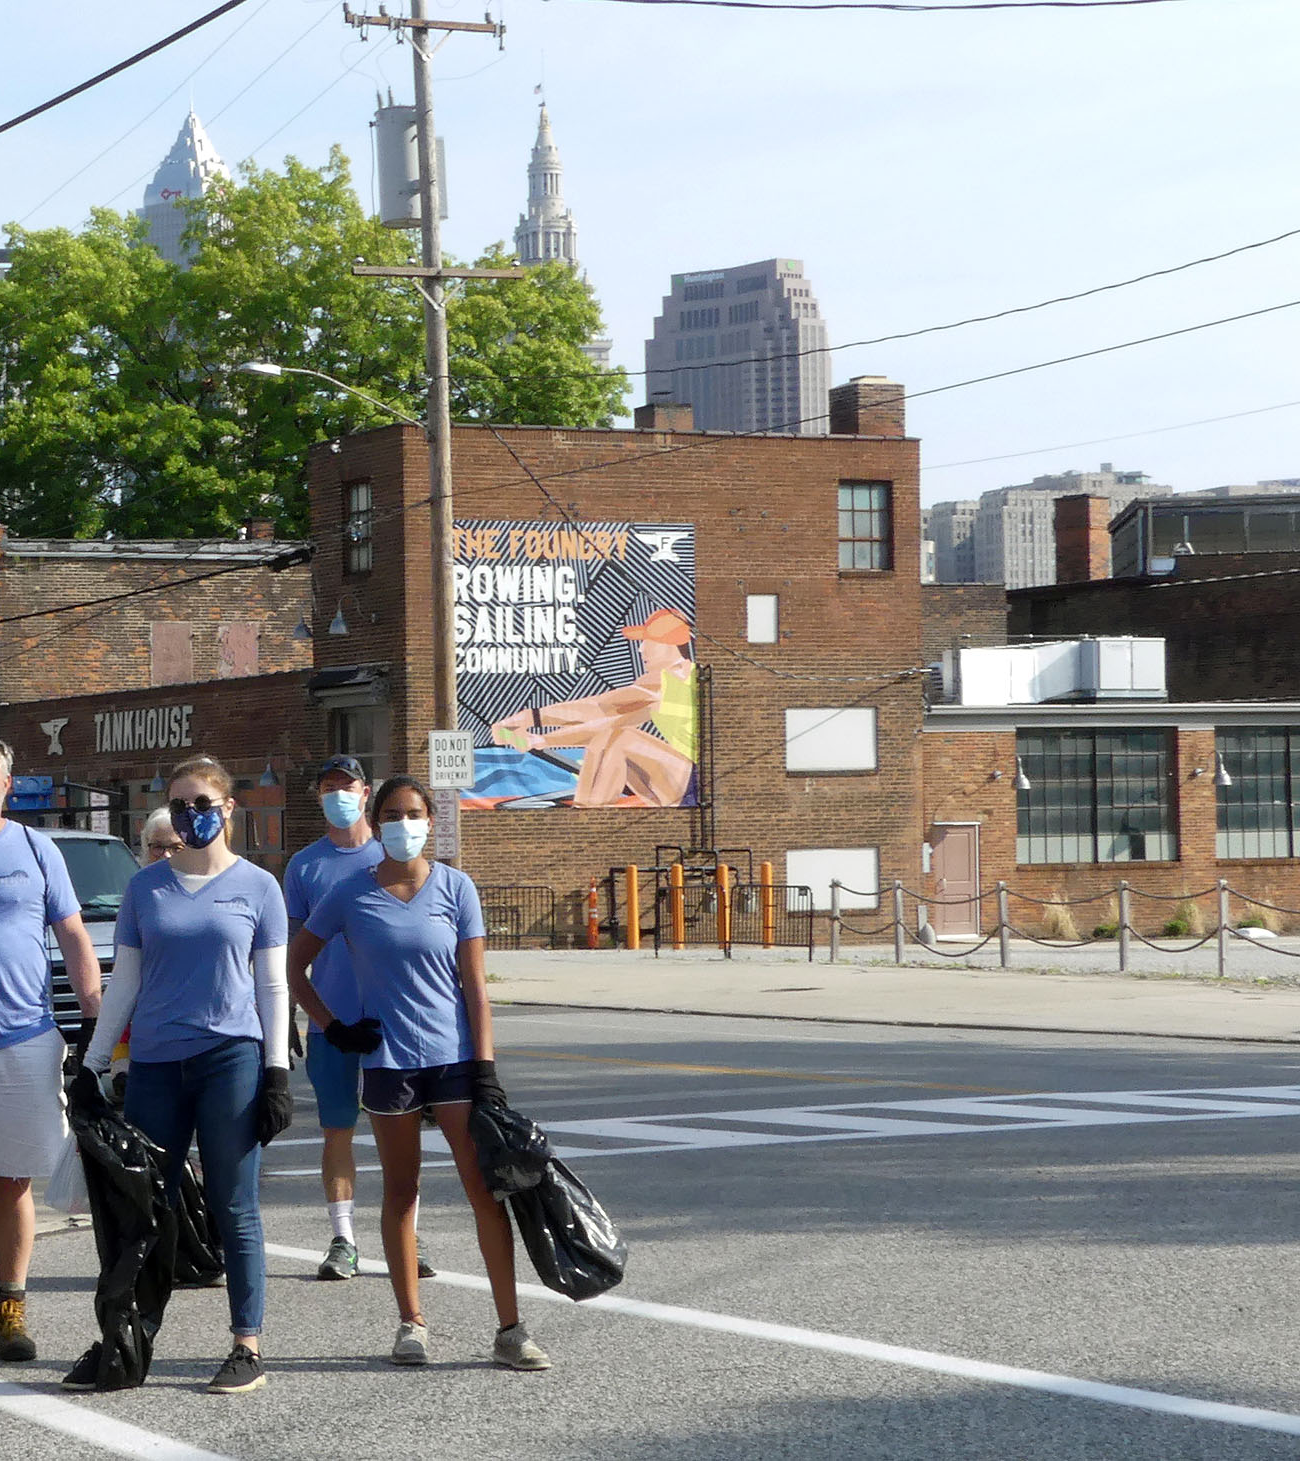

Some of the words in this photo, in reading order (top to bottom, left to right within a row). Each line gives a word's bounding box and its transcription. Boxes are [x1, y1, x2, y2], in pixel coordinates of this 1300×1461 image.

[453, 530, 501, 559] THE
[509, 530, 629, 560] FOUNDRY
[454, 565, 585, 603] ROWING.
[454, 606, 586, 643] SAILING.
[455, 646, 586, 675] COMMUNITY.
[94, 705, 193, 753] TANKHOUSE
[435, 739, 448, 752] DO
[450, 738, 468, 751] NOT
[435, 771, 468, 780] DRIVEWAY
[436, 755, 467, 768] BLOCK
